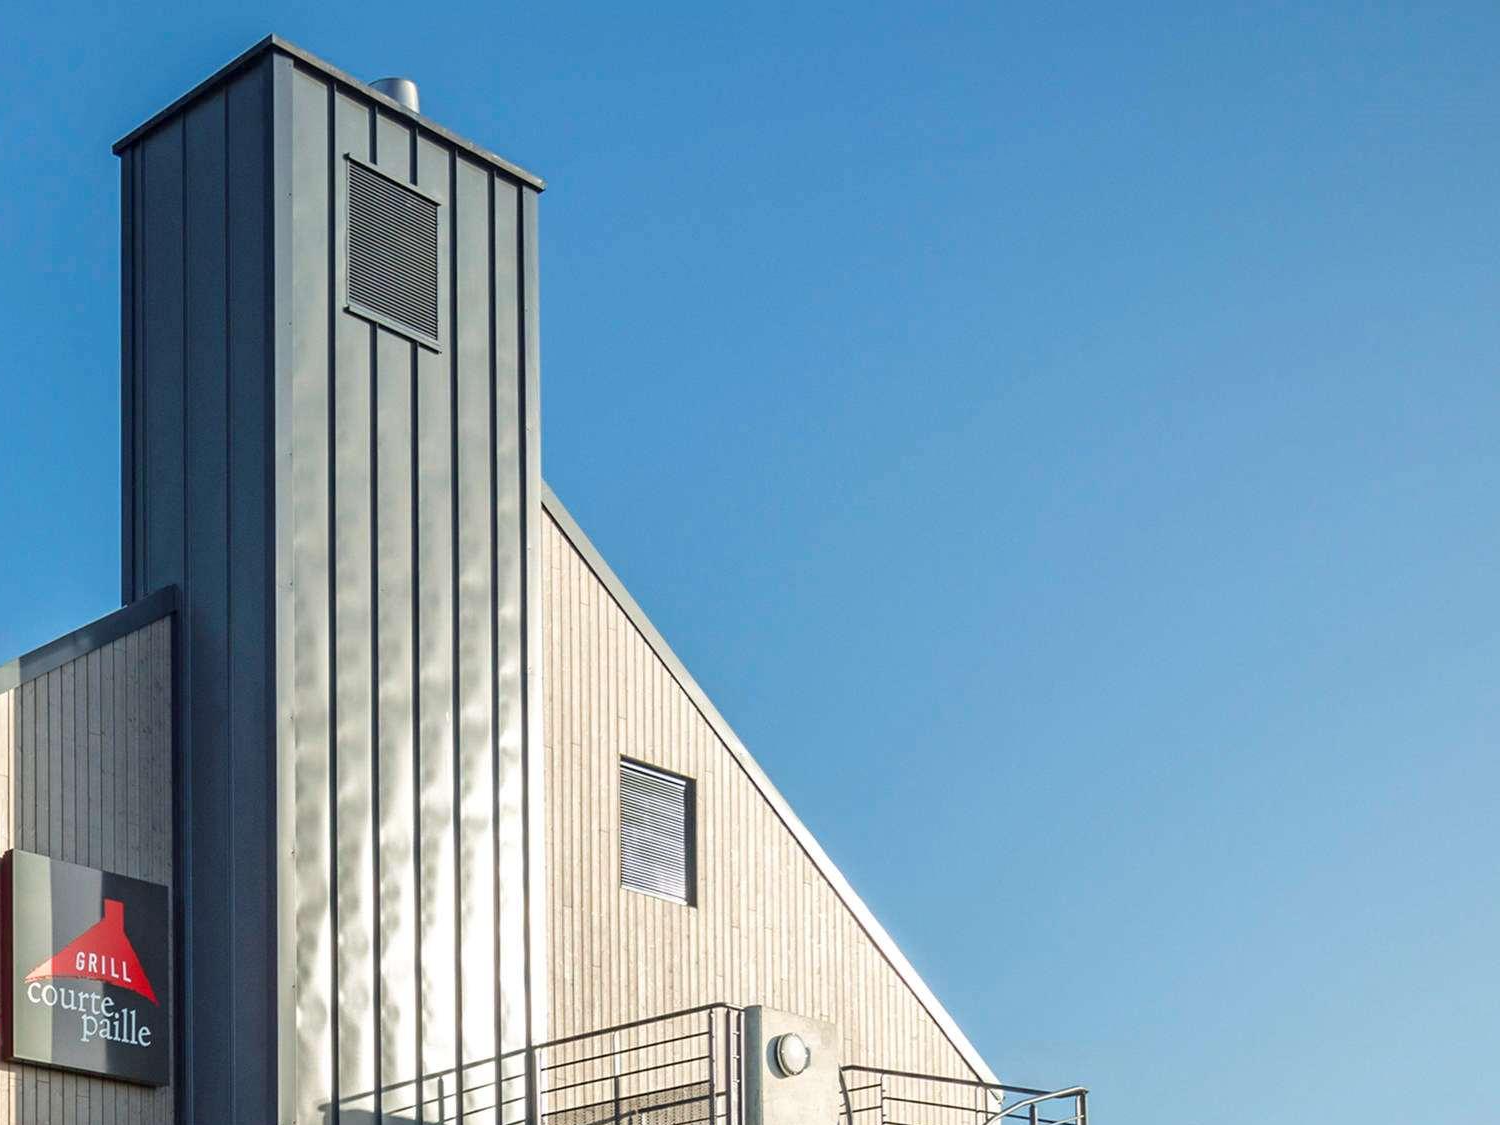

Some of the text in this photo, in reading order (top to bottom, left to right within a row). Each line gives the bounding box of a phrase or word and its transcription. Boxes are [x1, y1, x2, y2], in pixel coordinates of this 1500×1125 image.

[75, 951, 132, 983] GRILL
[27, 982, 115, 1017] courte
[80, 1008, 152, 1047] paille
